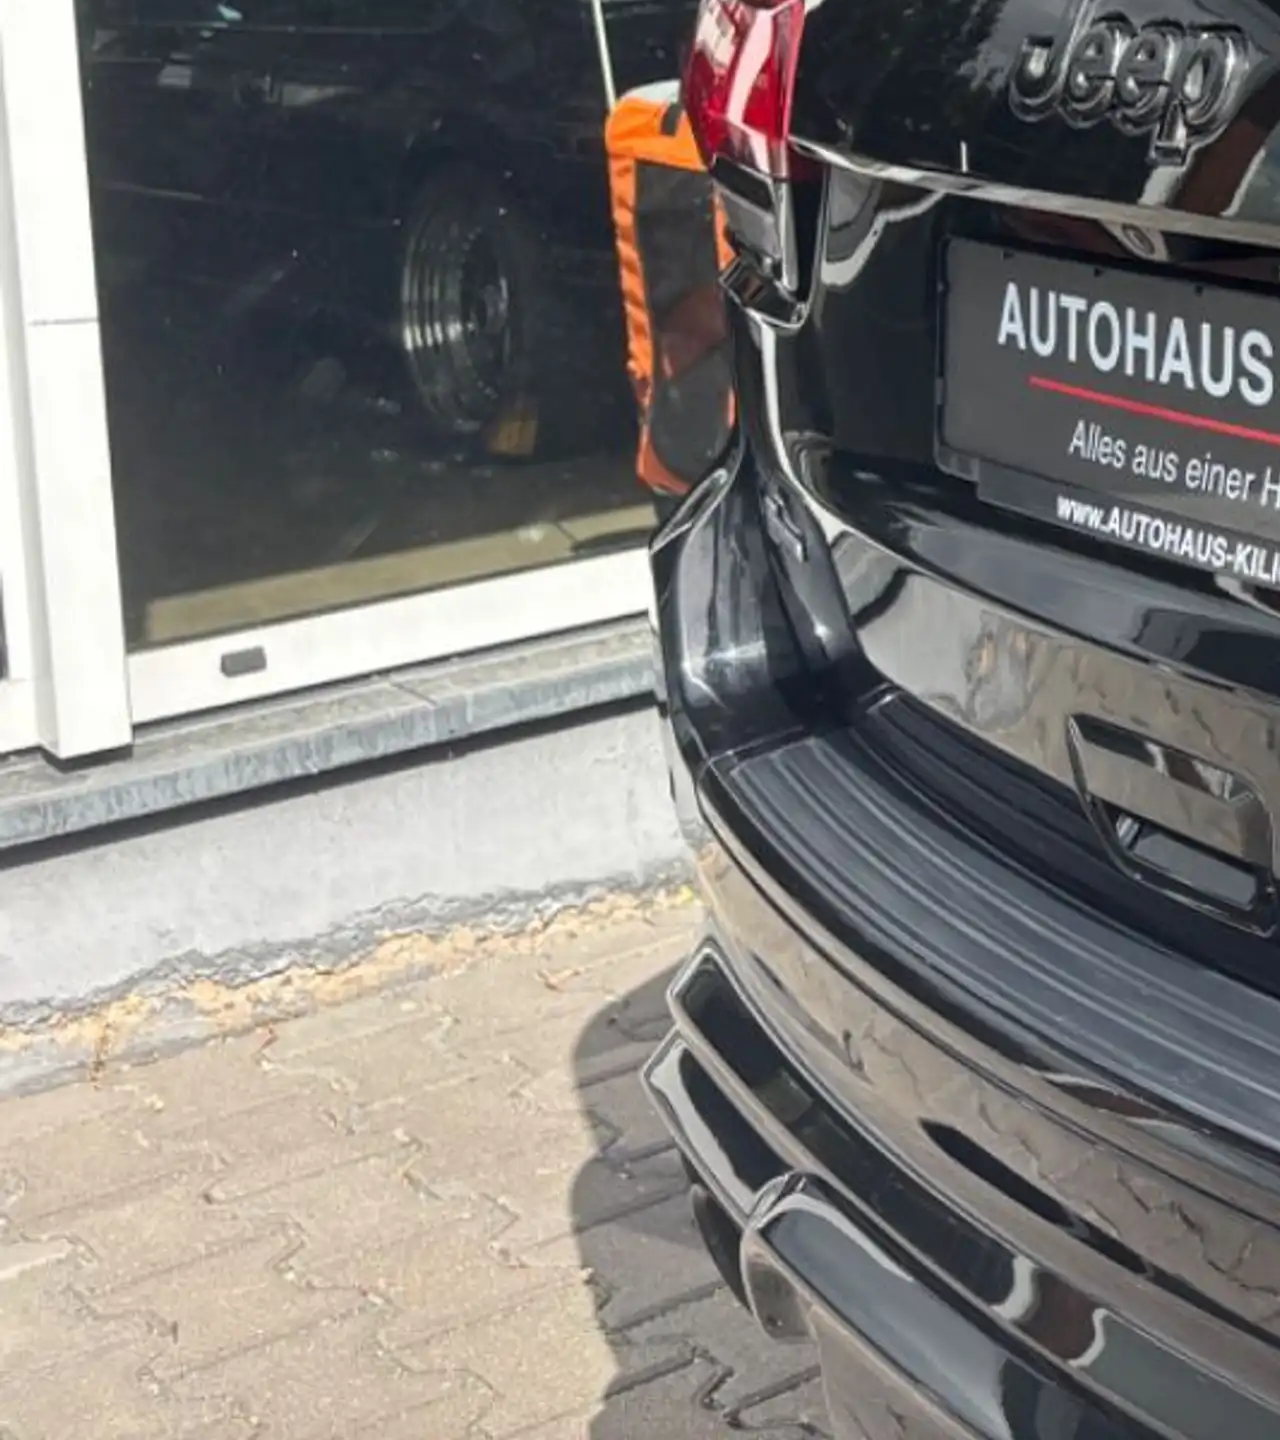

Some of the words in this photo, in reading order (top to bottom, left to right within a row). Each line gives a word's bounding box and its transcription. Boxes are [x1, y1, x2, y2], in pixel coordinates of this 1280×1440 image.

[997, 281, 1274, 407] AUTOHAUS
[1068, 418, 1126, 469] Alles
[1132, 442, 1179, 482] aus
[1184, 452, 1256, 503] einer
